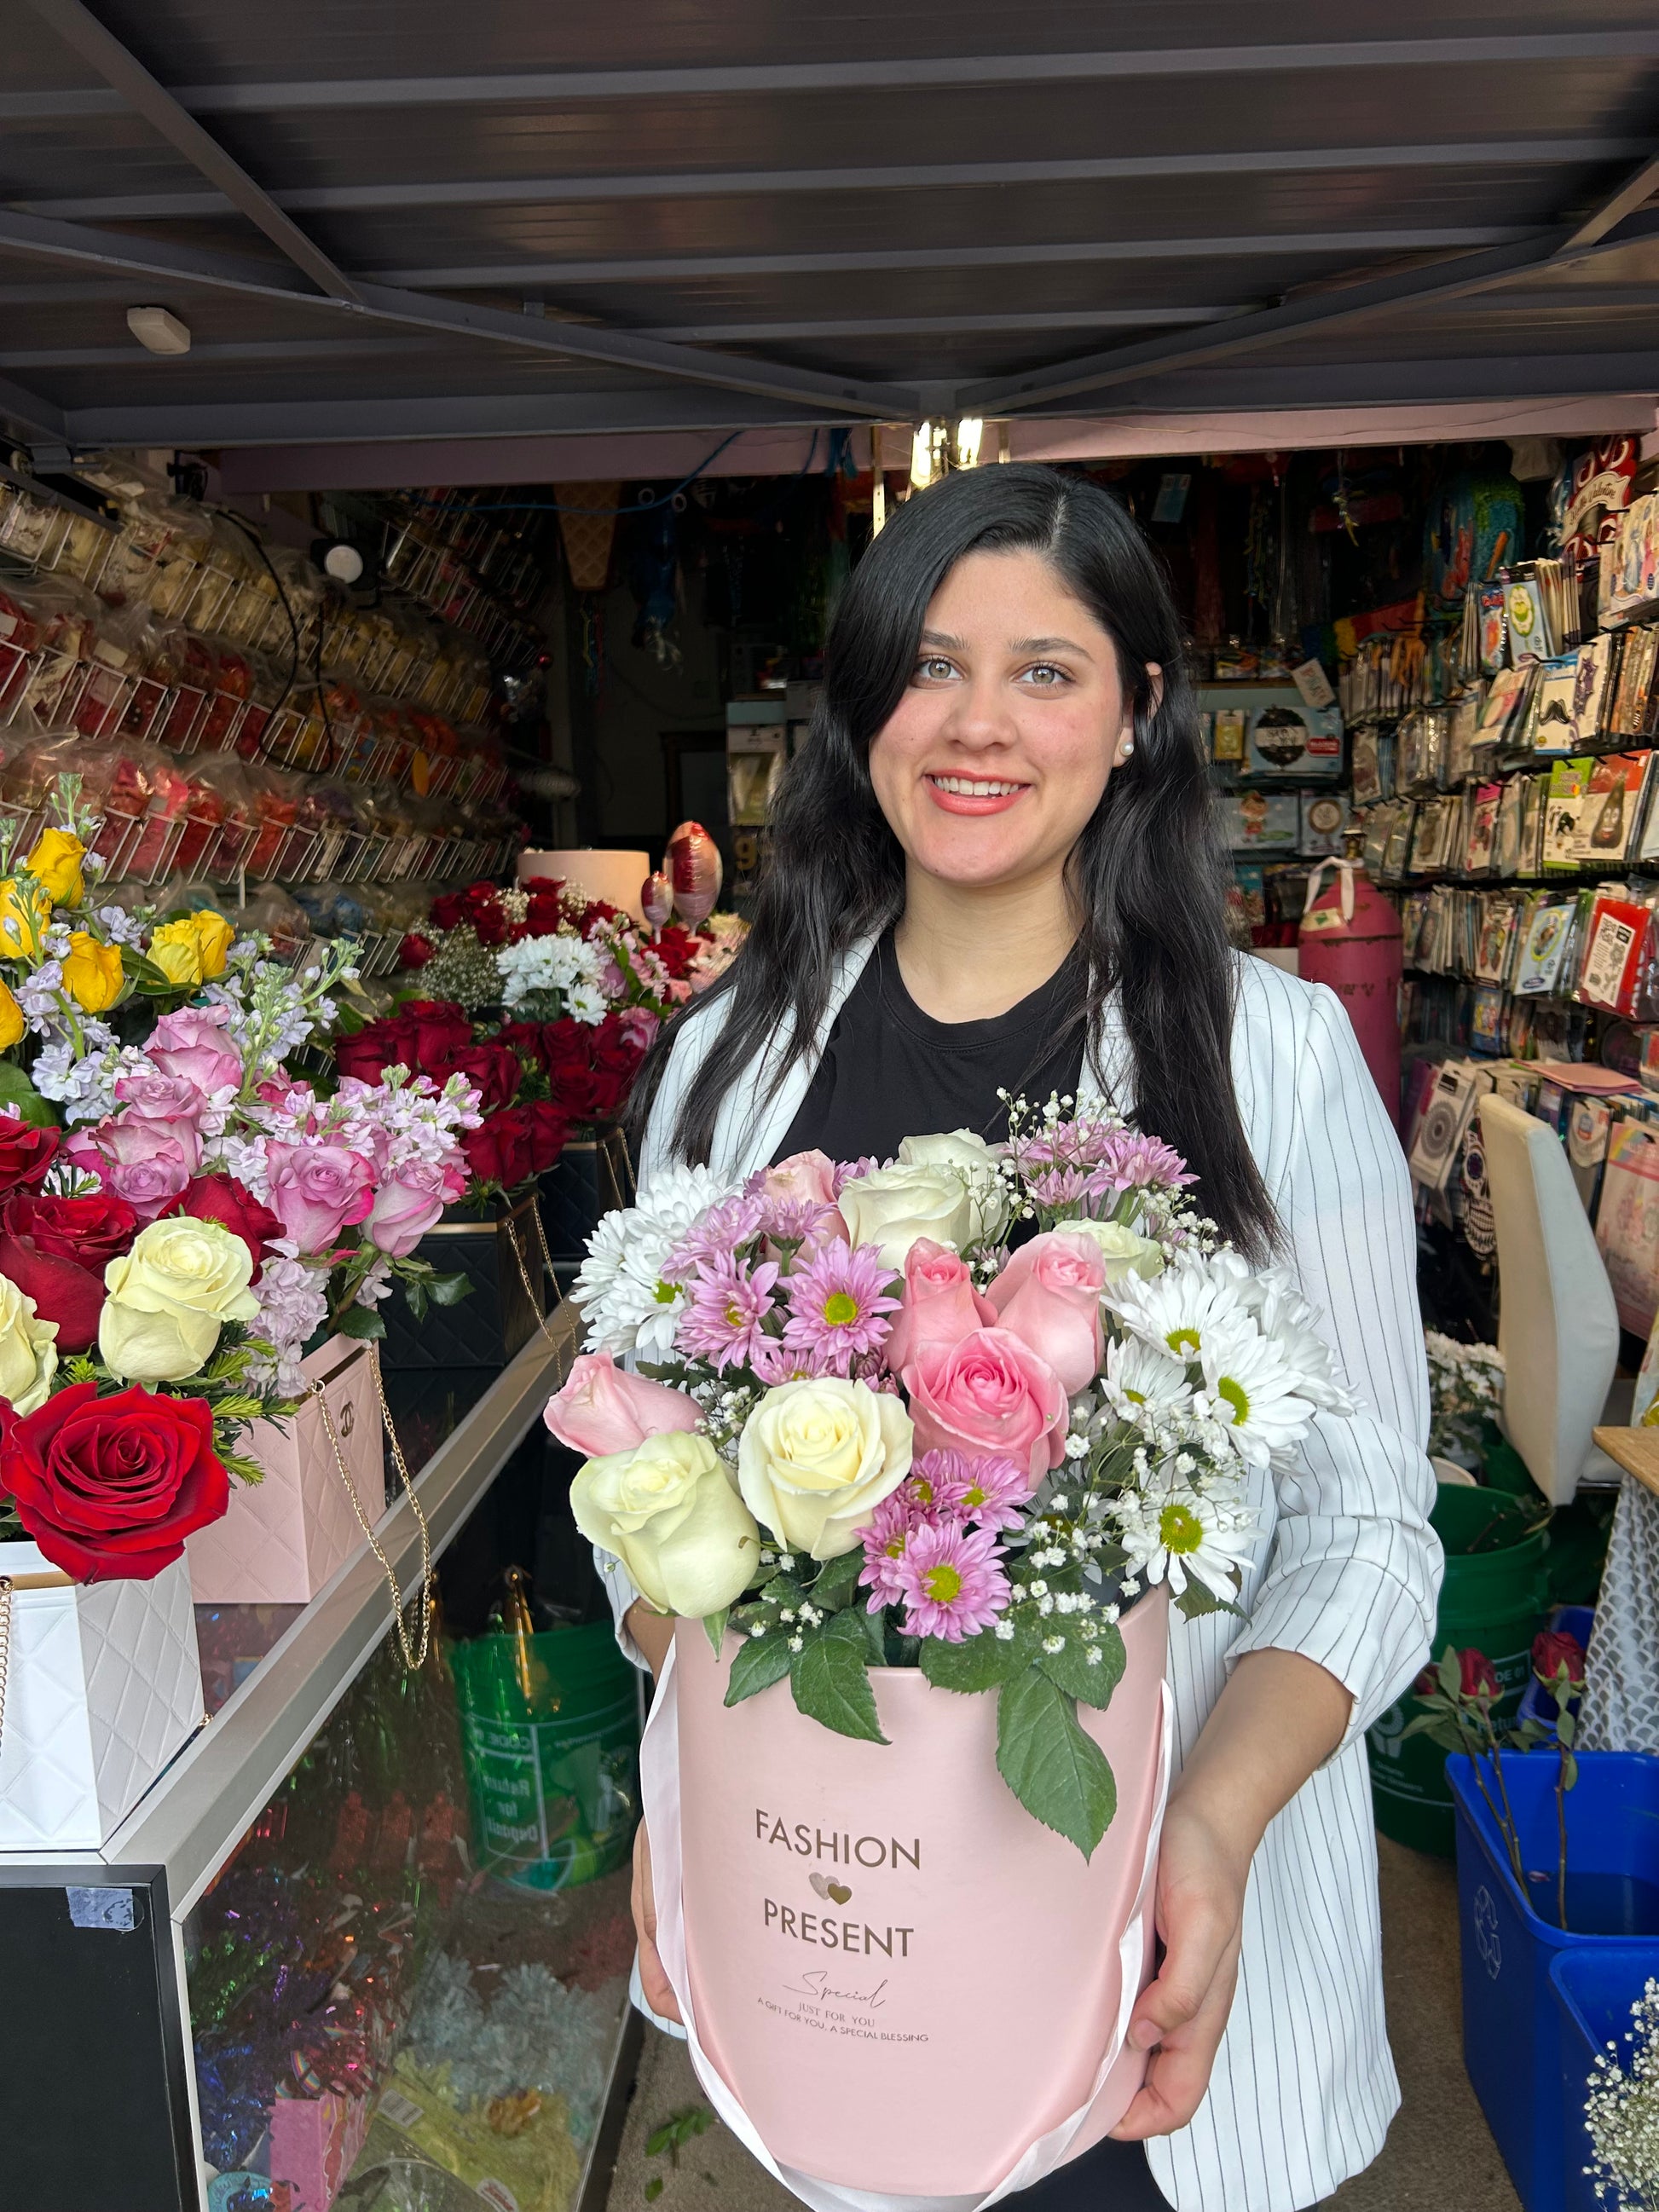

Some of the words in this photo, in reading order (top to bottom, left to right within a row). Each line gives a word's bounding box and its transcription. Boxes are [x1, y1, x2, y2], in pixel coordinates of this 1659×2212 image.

[756, 1808, 920, 1870] FASHION
[765, 1897, 915, 1958] PRESENT
[782, 1971, 888, 2008] Special
[765, 2001, 782, 2014] GIFT
[784, 2009, 802, 2023] FOR
[804, 2016, 827, 2031] YOU,
[840, 2026, 878, 2040] SPECIAL
[881, 2033, 929, 2042] BLESSING
[798, 2001, 821, 2017] JUST
[825, 2010, 846, 2023] FOR
[852, 2017, 875, 2027] YOU
